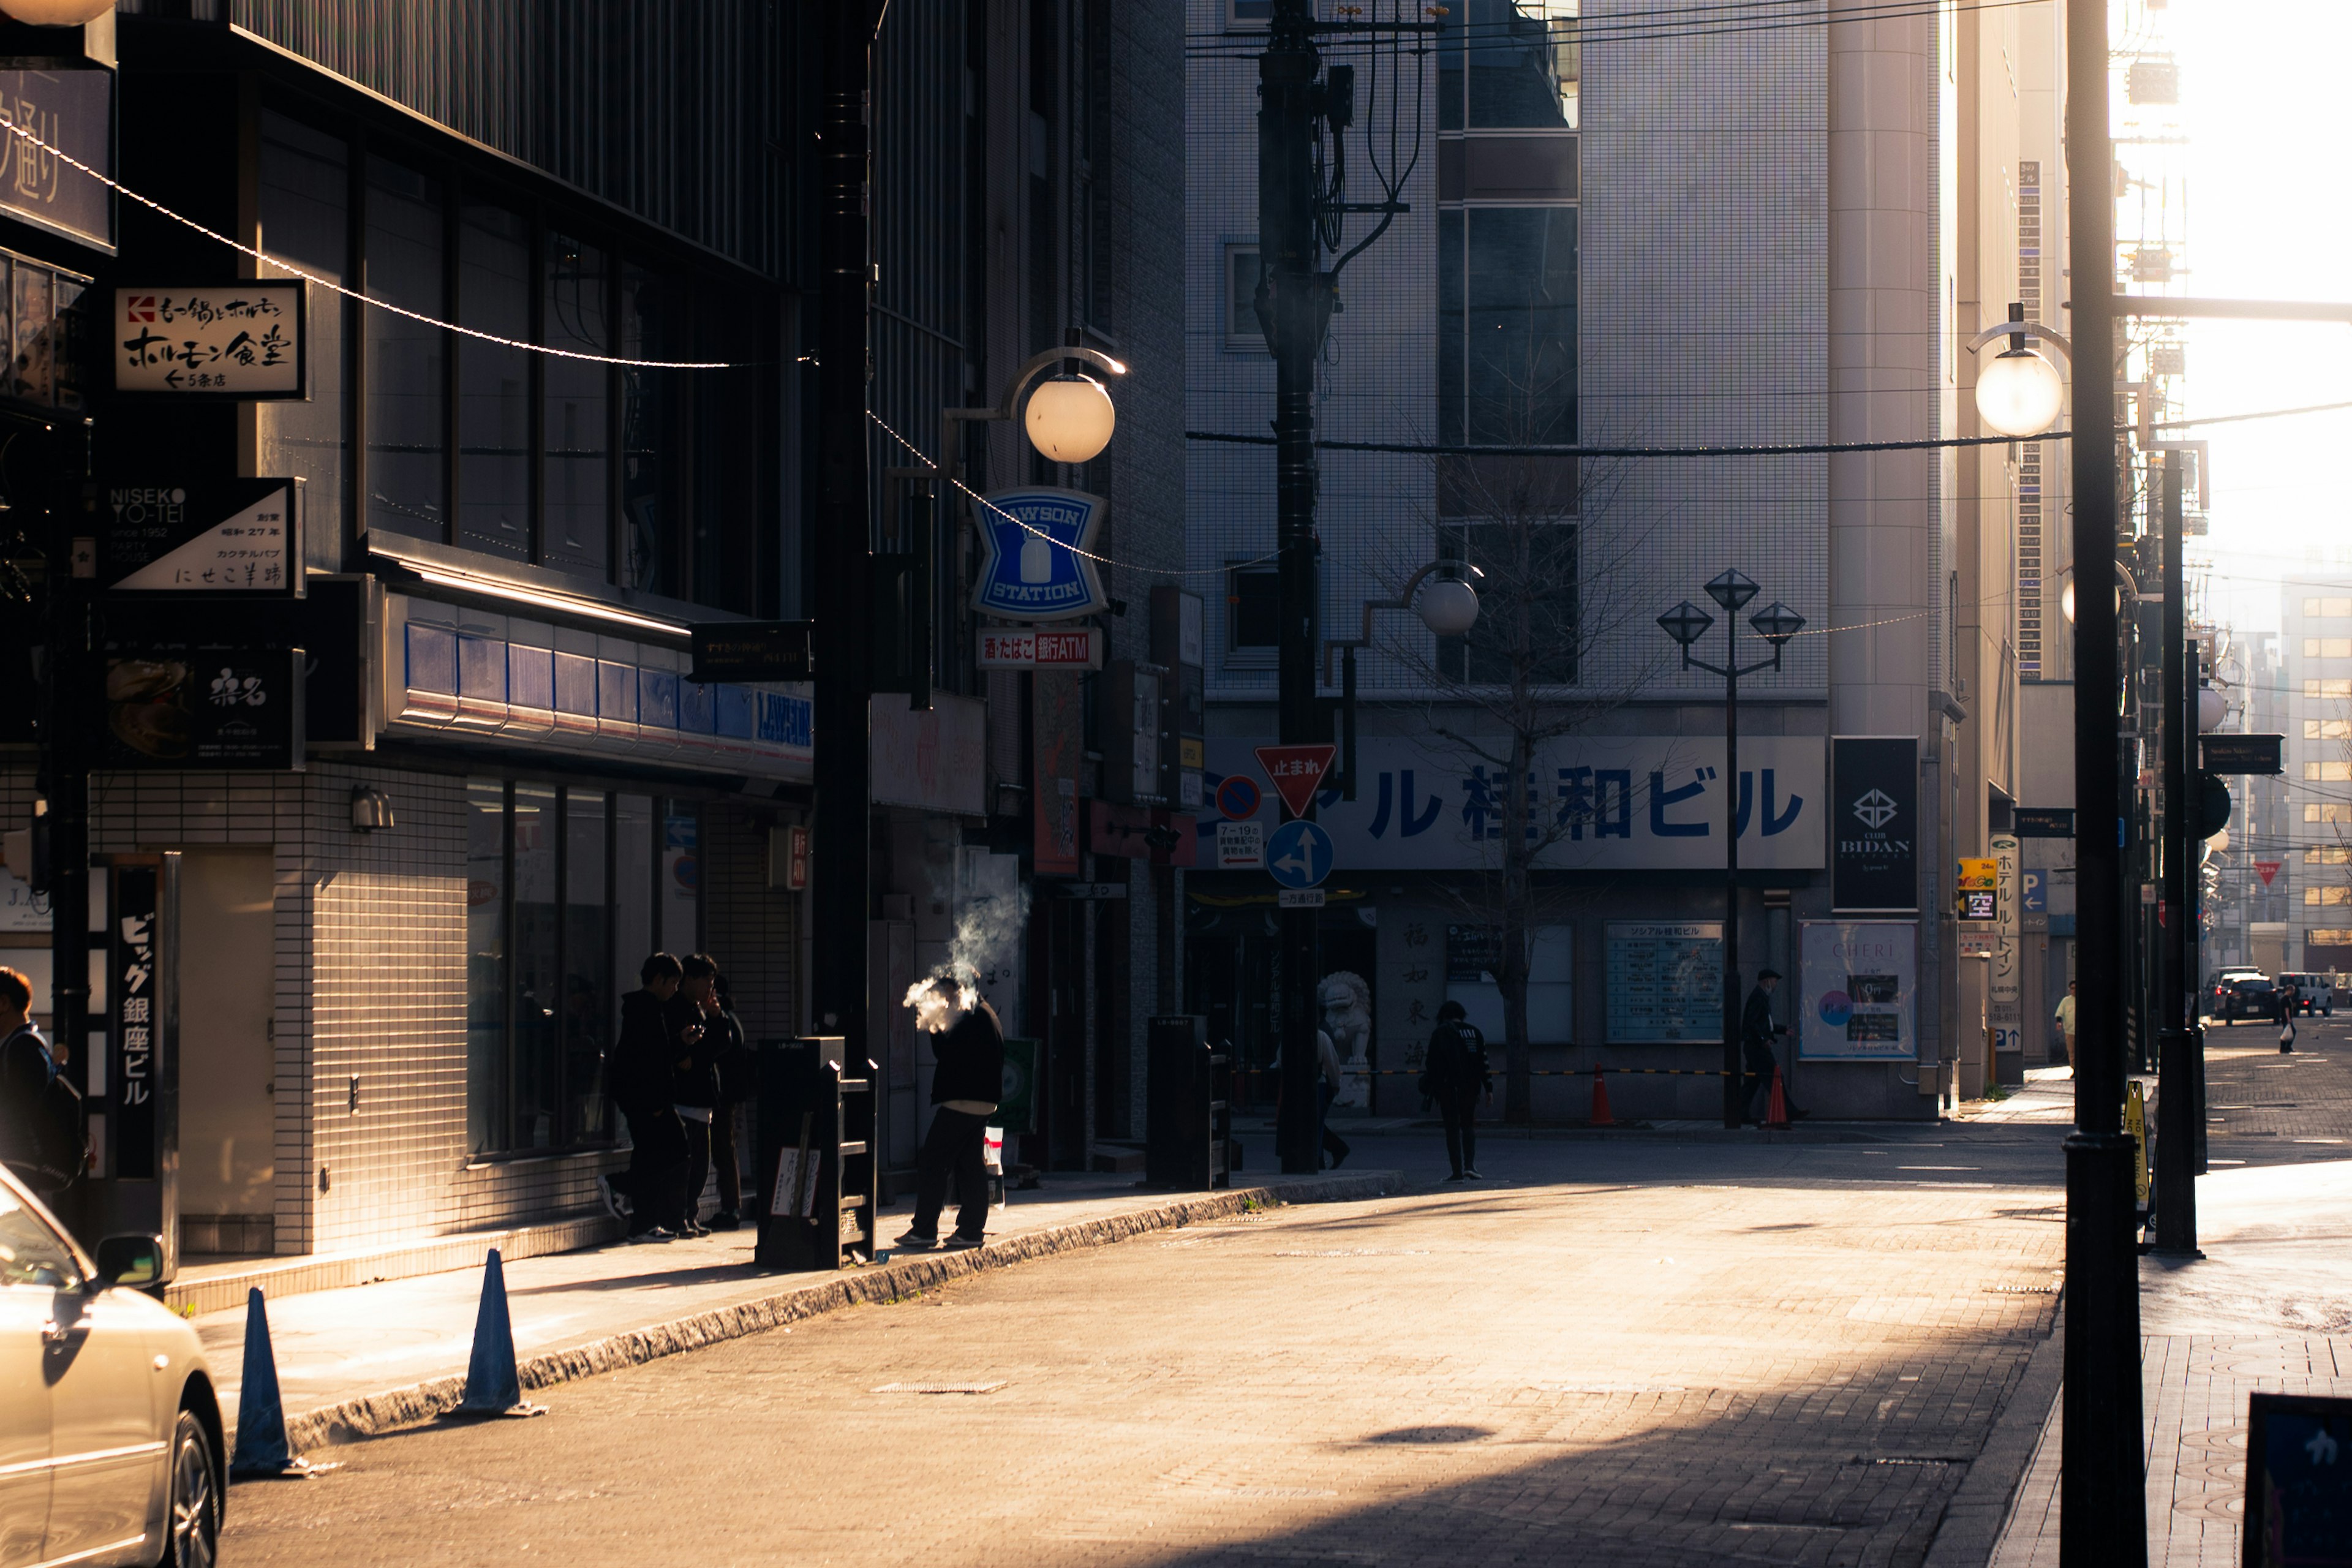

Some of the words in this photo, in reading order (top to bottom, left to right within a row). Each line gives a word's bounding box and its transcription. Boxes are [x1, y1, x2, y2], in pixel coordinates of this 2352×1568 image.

[159, 297, 283, 331] もつ鍋とホルモン
[123, 323, 292, 370] ホルモン食堂
[187, 372, 227, 388] 5条店
[110, 488, 186, 504] NISEKO
[112, 503, 184, 524] YO-TEI
[256, 513, 281, 522] 創業
[992, 507, 1080, 527] LAWSON
[110, 529, 138, 538] since
[141, 528, 168, 538] 1952
[221, 528, 245, 537] 昭和
[247, 528, 266, 537] 27
[268, 528, 281, 537] 年
[110, 541, 147, 551] PARTY
[216, 549, 282, 559] カクテルパブ
[110, 552, 151, 562] HOUSE
[175, 561, 282, 587] にせこ羊蹄
[992, 581, 1080, 601] STATION
[984, 637, 1033, 660] 酒・たばこ
[1038, 636, 1087, 661] 銀行ATM
[1272, 759, 1321, 776] 止まれ
[794, 833, 806, 856] 銀行
[1219, 835, 1261, 845] 貨物集配中の
[1840, 840, 1910, 853] BIDAN
[1222, 846, 1259, 856] 貨物を除く
[793, 858, 806, 881] ATM
[1999, 855, 2013, 902] ホテル
[2023, 874, 2039, 894] P
[1280, 893, 1324, 903] 一方通行路
[1969, 892, 1993, 917] 空
[1631, 927, 1700, 936] ソシアル桂和ビル
[121, 912, 154, 1105] ビッグ銀座ビル
[2135, 1118, 2141, 1133] NO
